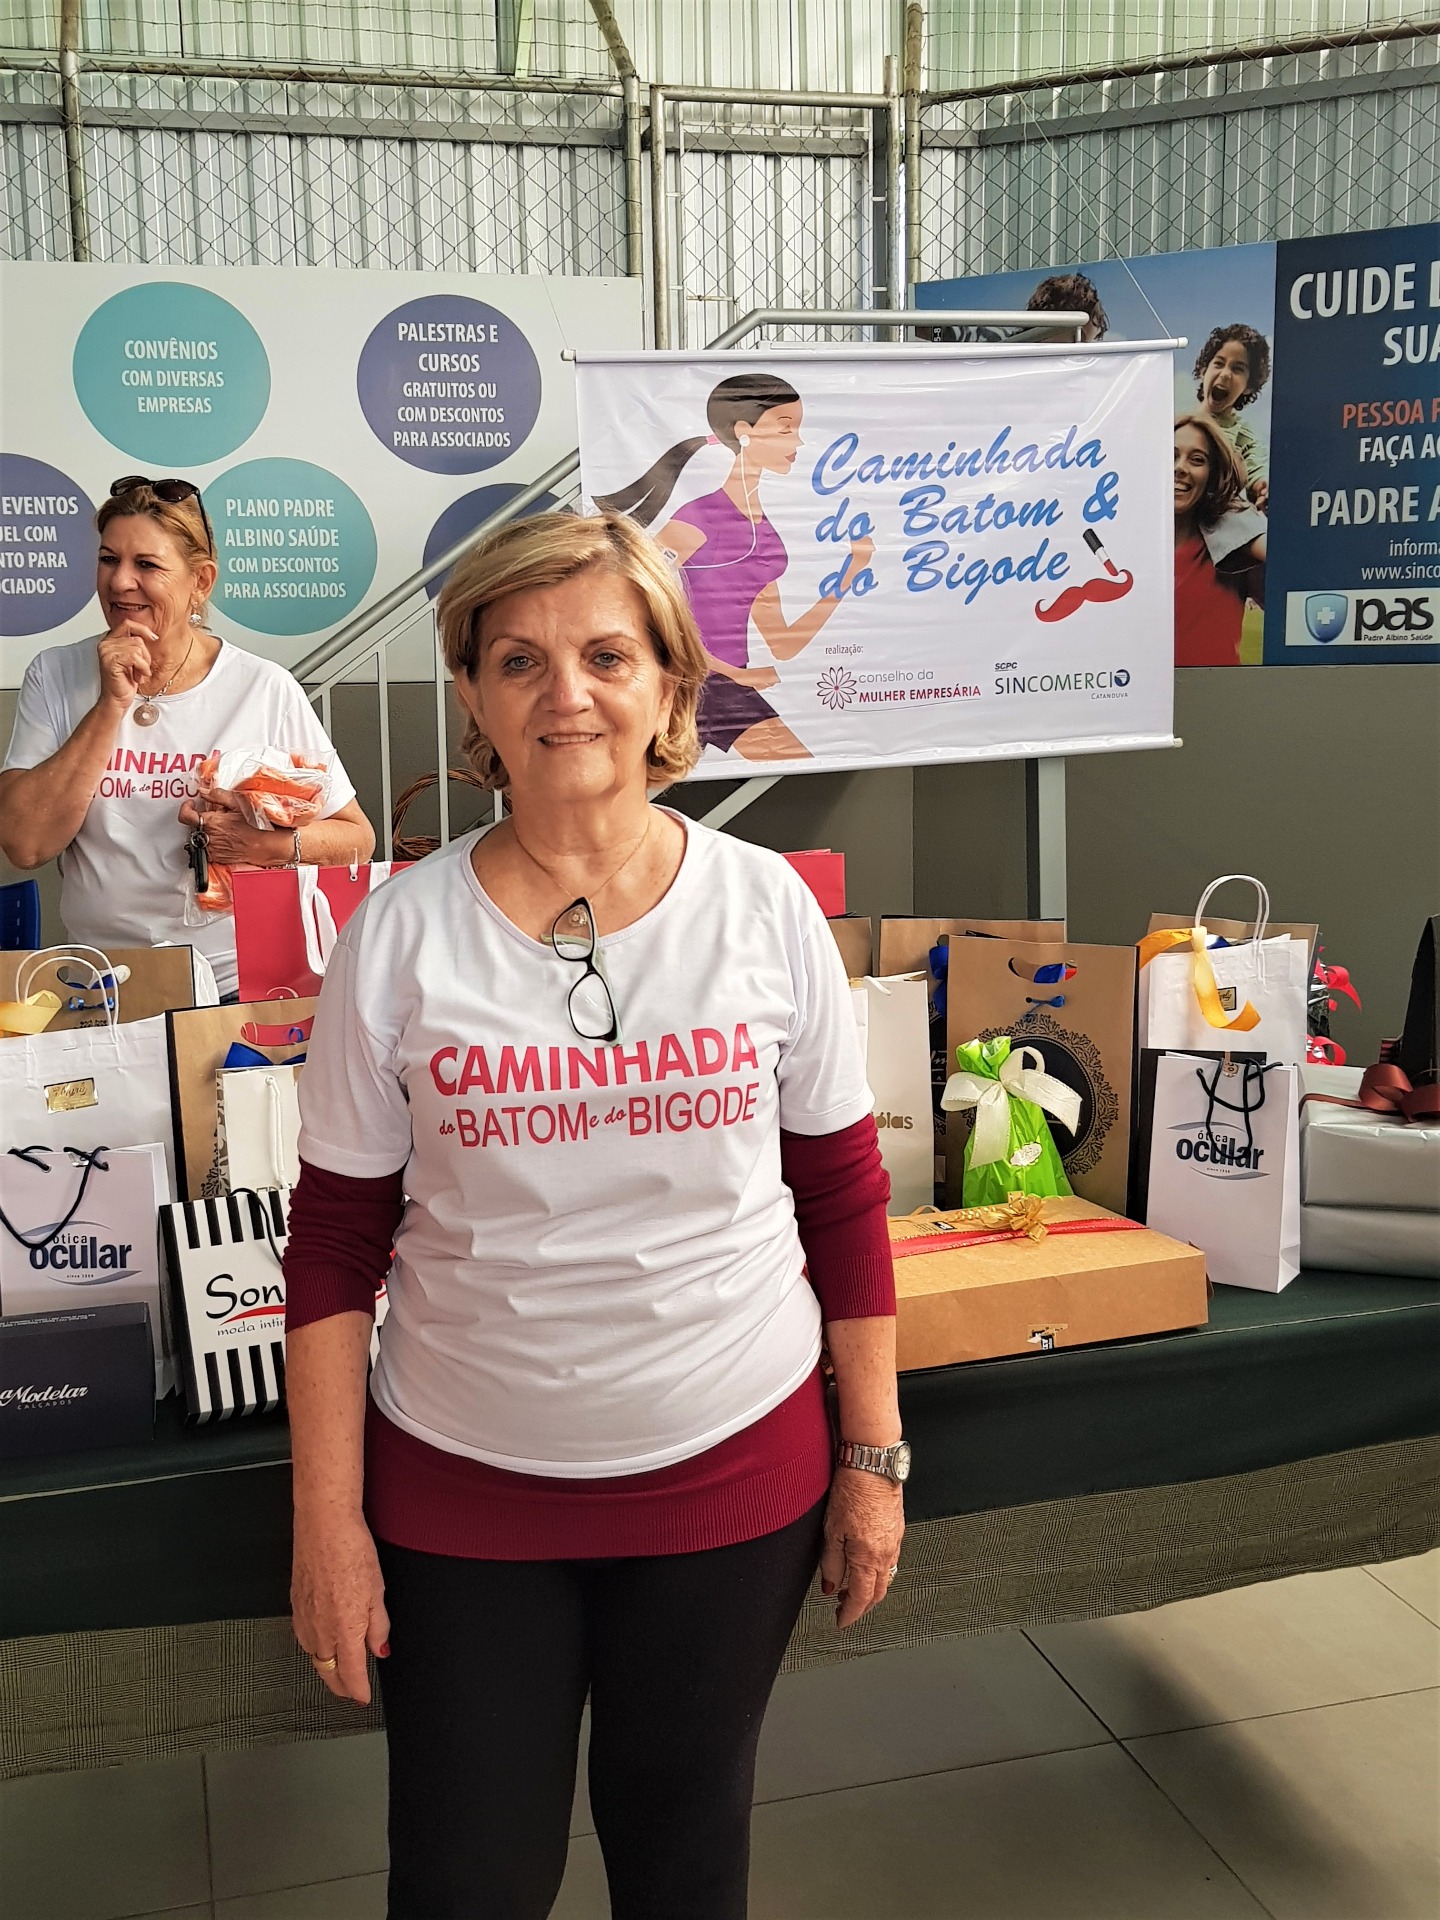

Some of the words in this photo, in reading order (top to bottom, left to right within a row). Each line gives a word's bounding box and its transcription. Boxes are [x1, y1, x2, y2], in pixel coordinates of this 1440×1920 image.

[1290, 262, 1416, 320] CUIDE
[397, 322, 486, 343] PALESTRAS
[489, 324, 499, 343] E
[124, 337, 219, 360] CONVÊNIOS
[418, 353, 480, 373] CURSOS
[121, 369, 153, 386] COM
[156, 370, 225, 388] DIVERSAS
[402, 382, 475, 398] GRATUITOS
[478, 383, 497, 399] OU
[137, 396, 212, 414] EMPRESAS
[397, 406, 427, 422] COM
[430, 407, 505, 423] DESCONTOS
[1342, 399, 1425, 429] PESSOA
[393, 431, 429, 447] PARA
[431, 431, 511, 448] ASSOCIADOS
[811, 424, 1107, 496] Caminhada
[1359, 434, 1415, 468] FAÇA
[2, 496, 79, 516] EVENTOS
[226, 498, 280, 517] PLANO
[283, 499, 335, 518] PADRE
[815, 497, 876, 543] do
[899, 484, 1063, 537] Batom
[1082, 471, 1119, 523] &
[1310, 485, 1420, 527] PADRE
[23, 525, 58, 542] COM
[224, 528, 285, 547] ALBINO
[288, 525, 340, 547] SAÚDE
[28, 551, 68, 568] PARA
[228, 557, 259, 573] COM
[262, 557, 340, 573] DESCONTOS
[818, 553, 879, 600] do
[902, 537, 1071, 606] Bigode
[0, 577, 56, 595] CIADOS
[224, 582, 260, 599] PARA
[263, 582, 347, 599] ASSOCIADOS
[1354, 597, 1434, 641] pas
[1386, 633, 1408, 641] Albino
[825, 643, 864, 656] realização:
[994, 662, 1018, 670] SCPC
[858, 672, 914, 685] conselho
[915, 669, 934, 681] da
[859, 689, 906, 704] MULHER
[909, 684, 982, 700] EMPRESÁRIA
[429, 1023, 760, 1097] CAMINHADA
[439, 1119, 456, 1136] do
[455, 1101, 589, 1147] BATOM
[588, 1115, 600, 1129] e
[603, 1105, 627, 1126] do
[627, 1081, 760, 1137] BIGODE
[1197, 1130, 1228, 1143] ótica
[1176, 1137, 1265, 1170] ocular
[29, 1236, 132, 1270] ocular
[205, 1273, 285, 1319] Son
[217, 1321, 256, 1337] moda
